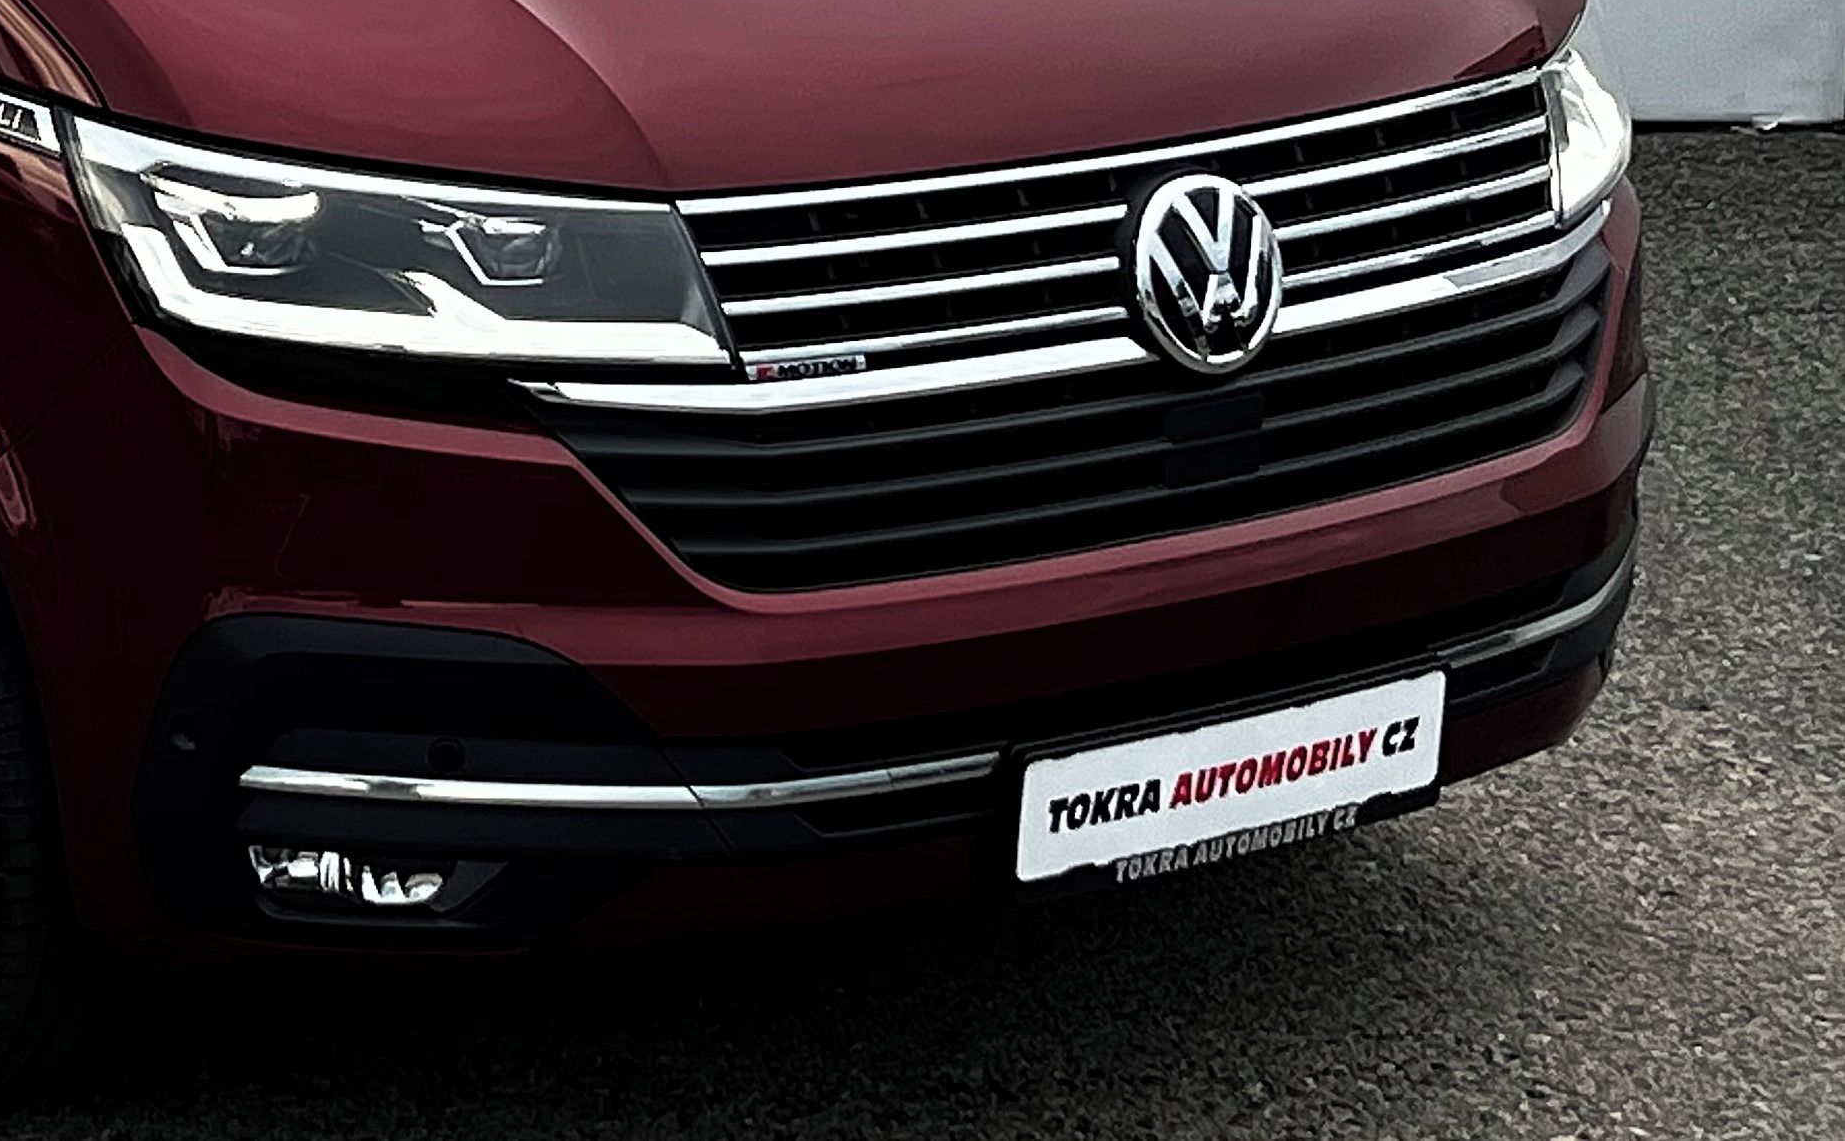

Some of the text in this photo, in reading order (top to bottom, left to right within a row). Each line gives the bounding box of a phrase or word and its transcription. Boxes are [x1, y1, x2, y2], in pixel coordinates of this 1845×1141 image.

[1048, 716, 1420, 833] TOKRA AUTOMOBILY CZ
[1116, 806, 1359, 883] TOKRA AUTOMOBILY CZ
